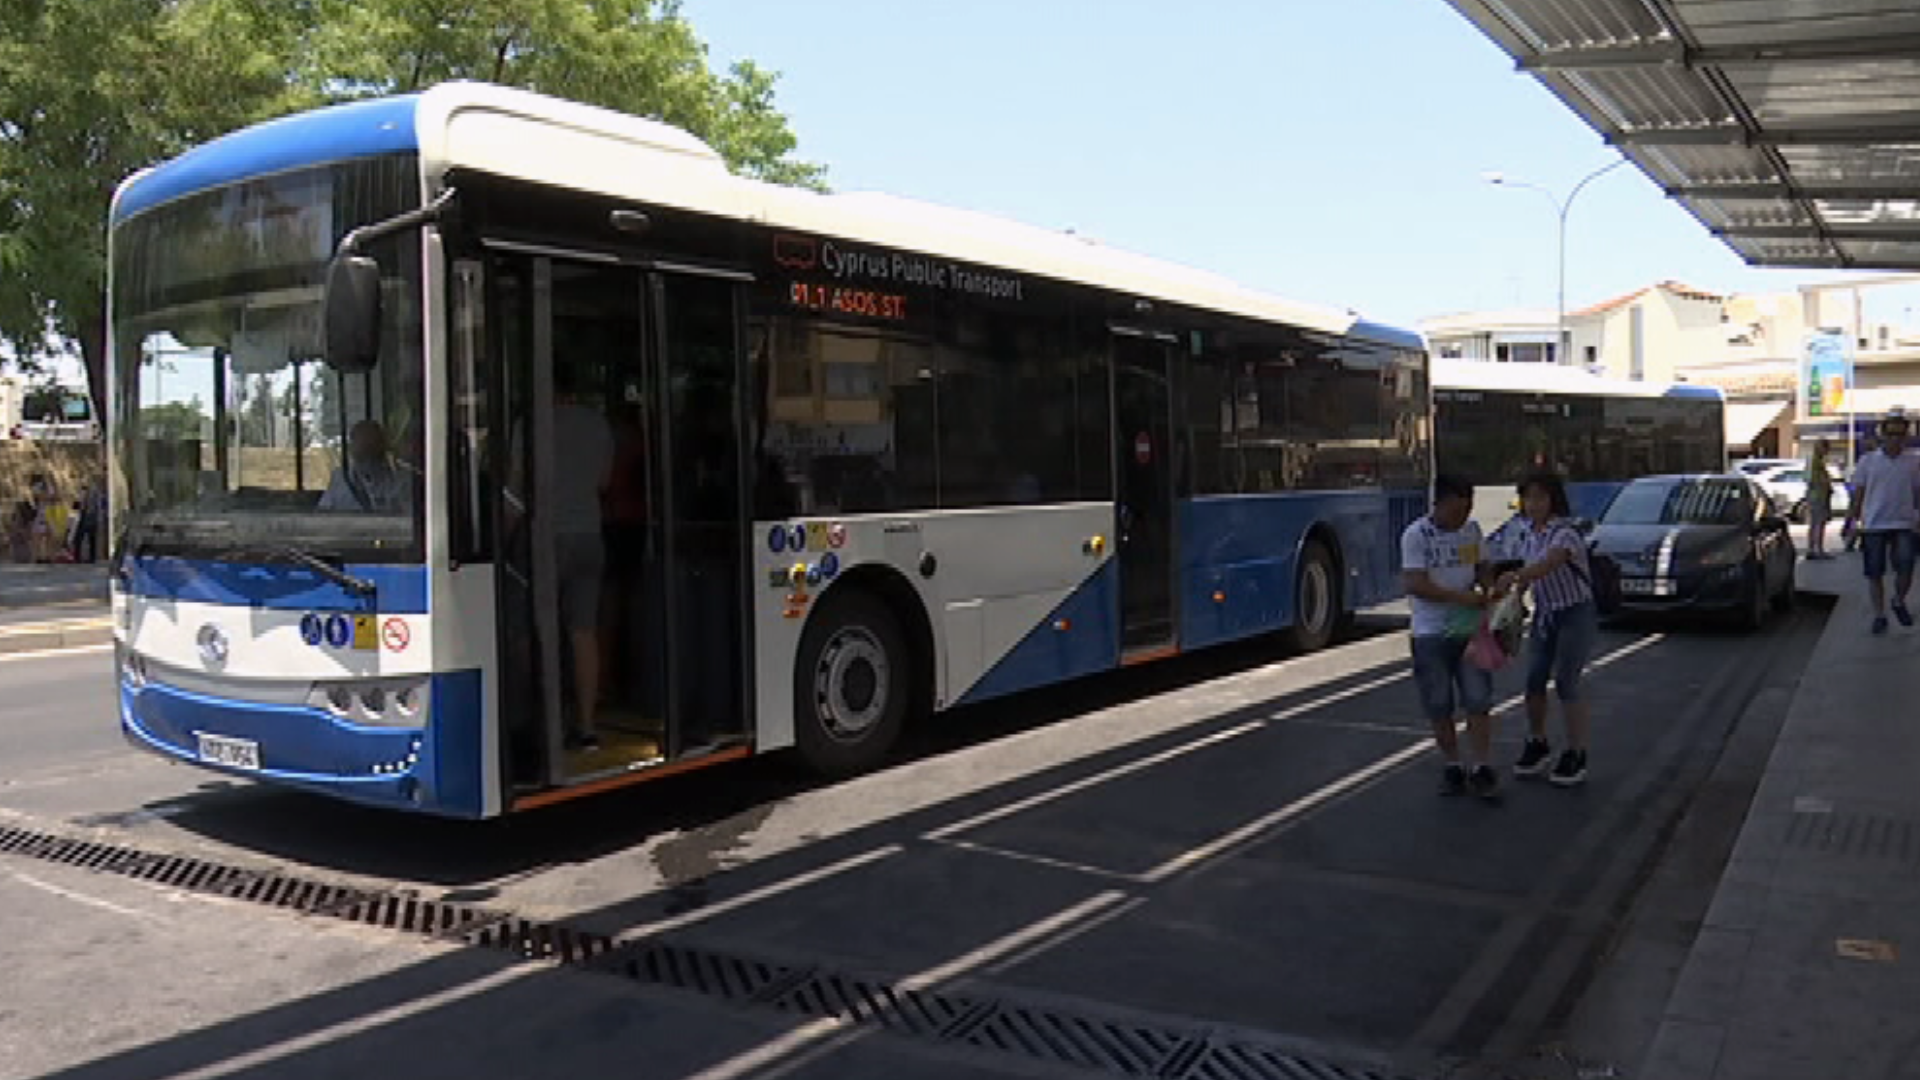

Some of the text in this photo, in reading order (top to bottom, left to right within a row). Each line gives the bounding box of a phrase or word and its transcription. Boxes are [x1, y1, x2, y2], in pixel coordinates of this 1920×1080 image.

[822, 241, 1023, 300] Cyprus Public Transport
